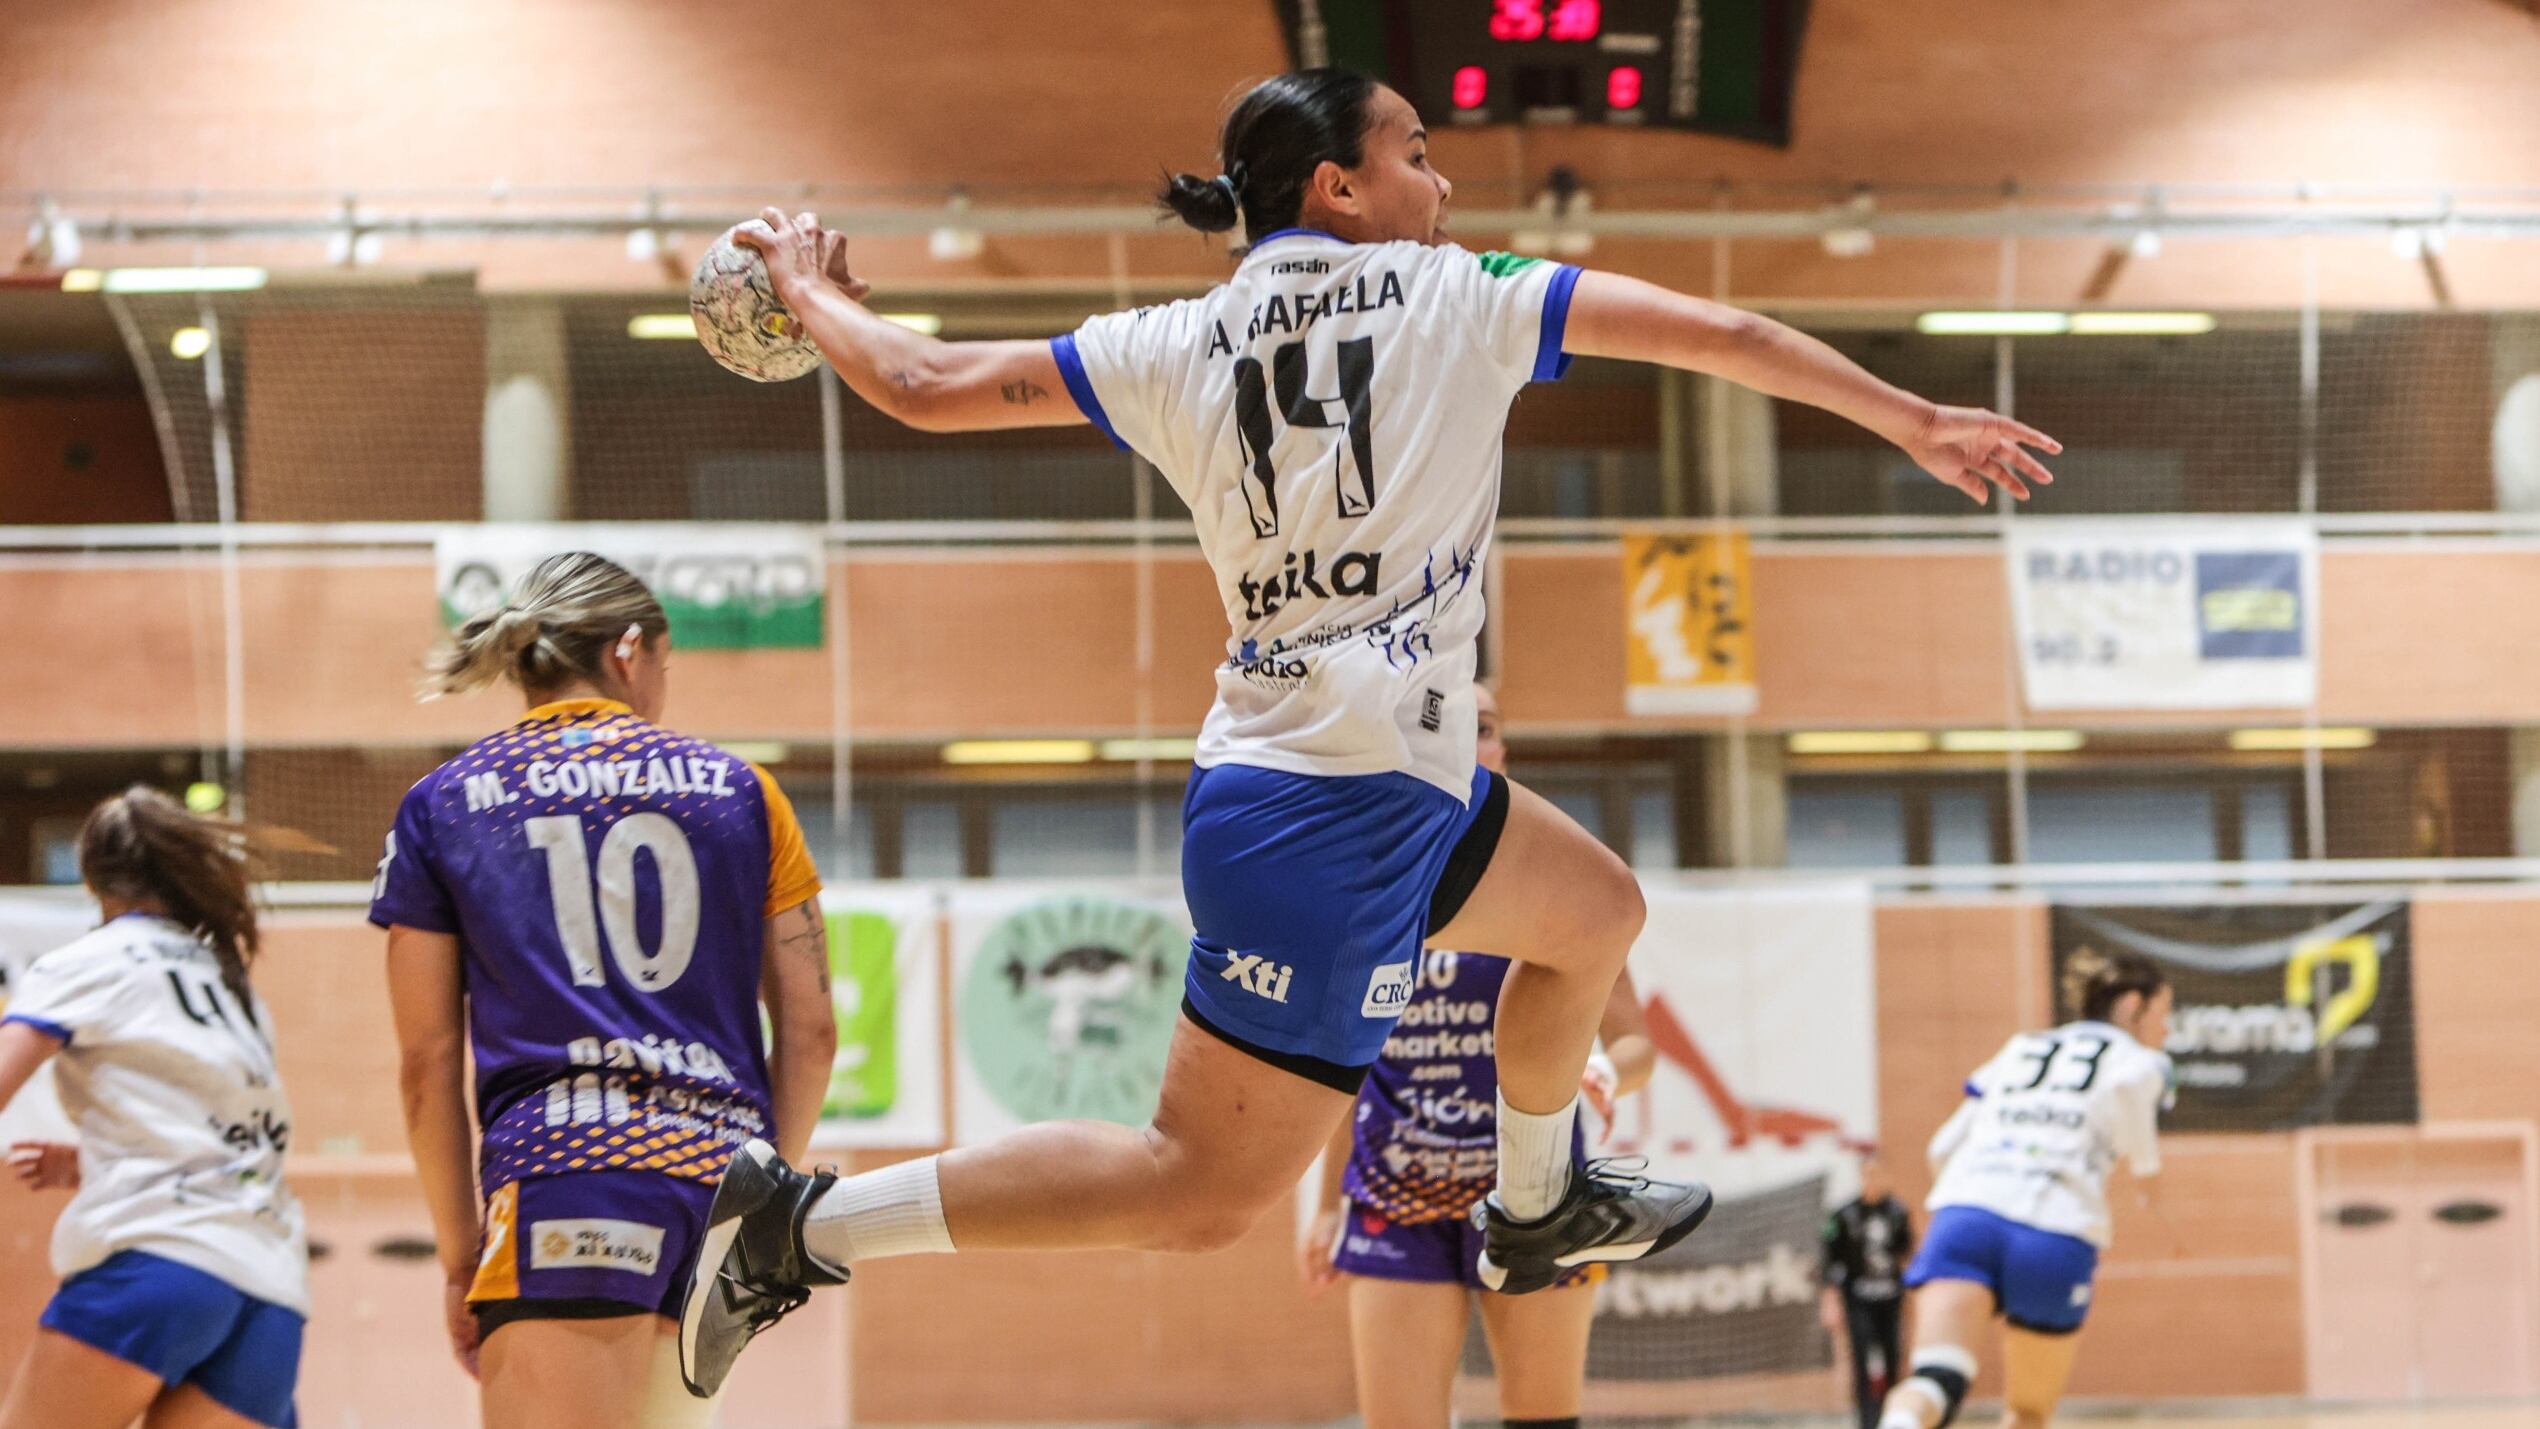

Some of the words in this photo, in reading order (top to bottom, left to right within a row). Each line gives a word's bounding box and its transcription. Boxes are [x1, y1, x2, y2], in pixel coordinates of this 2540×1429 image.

[1208, 319, 1242, 360] A.
[1247, 270, 1405, 342] RAFAELA
[1234, 335, 1376, 540] 14
[1238, 549, 1382, 621] teika
[2026, 552, 2182, 585] RADIO
[463, 772, 521, 813] M.
[526, 748, 735, 798] GONZÁLEZ
[523, 811, 701, 993] 10
[1219, 948, 1294, 1004] Xti
[1371, 980, 1412, 1004] CRC
[1397, 996, 1488, 1027] otive
[2163, 1005, 2316, 1053] urama
[2003, 1037, 2111, 1092] 33
